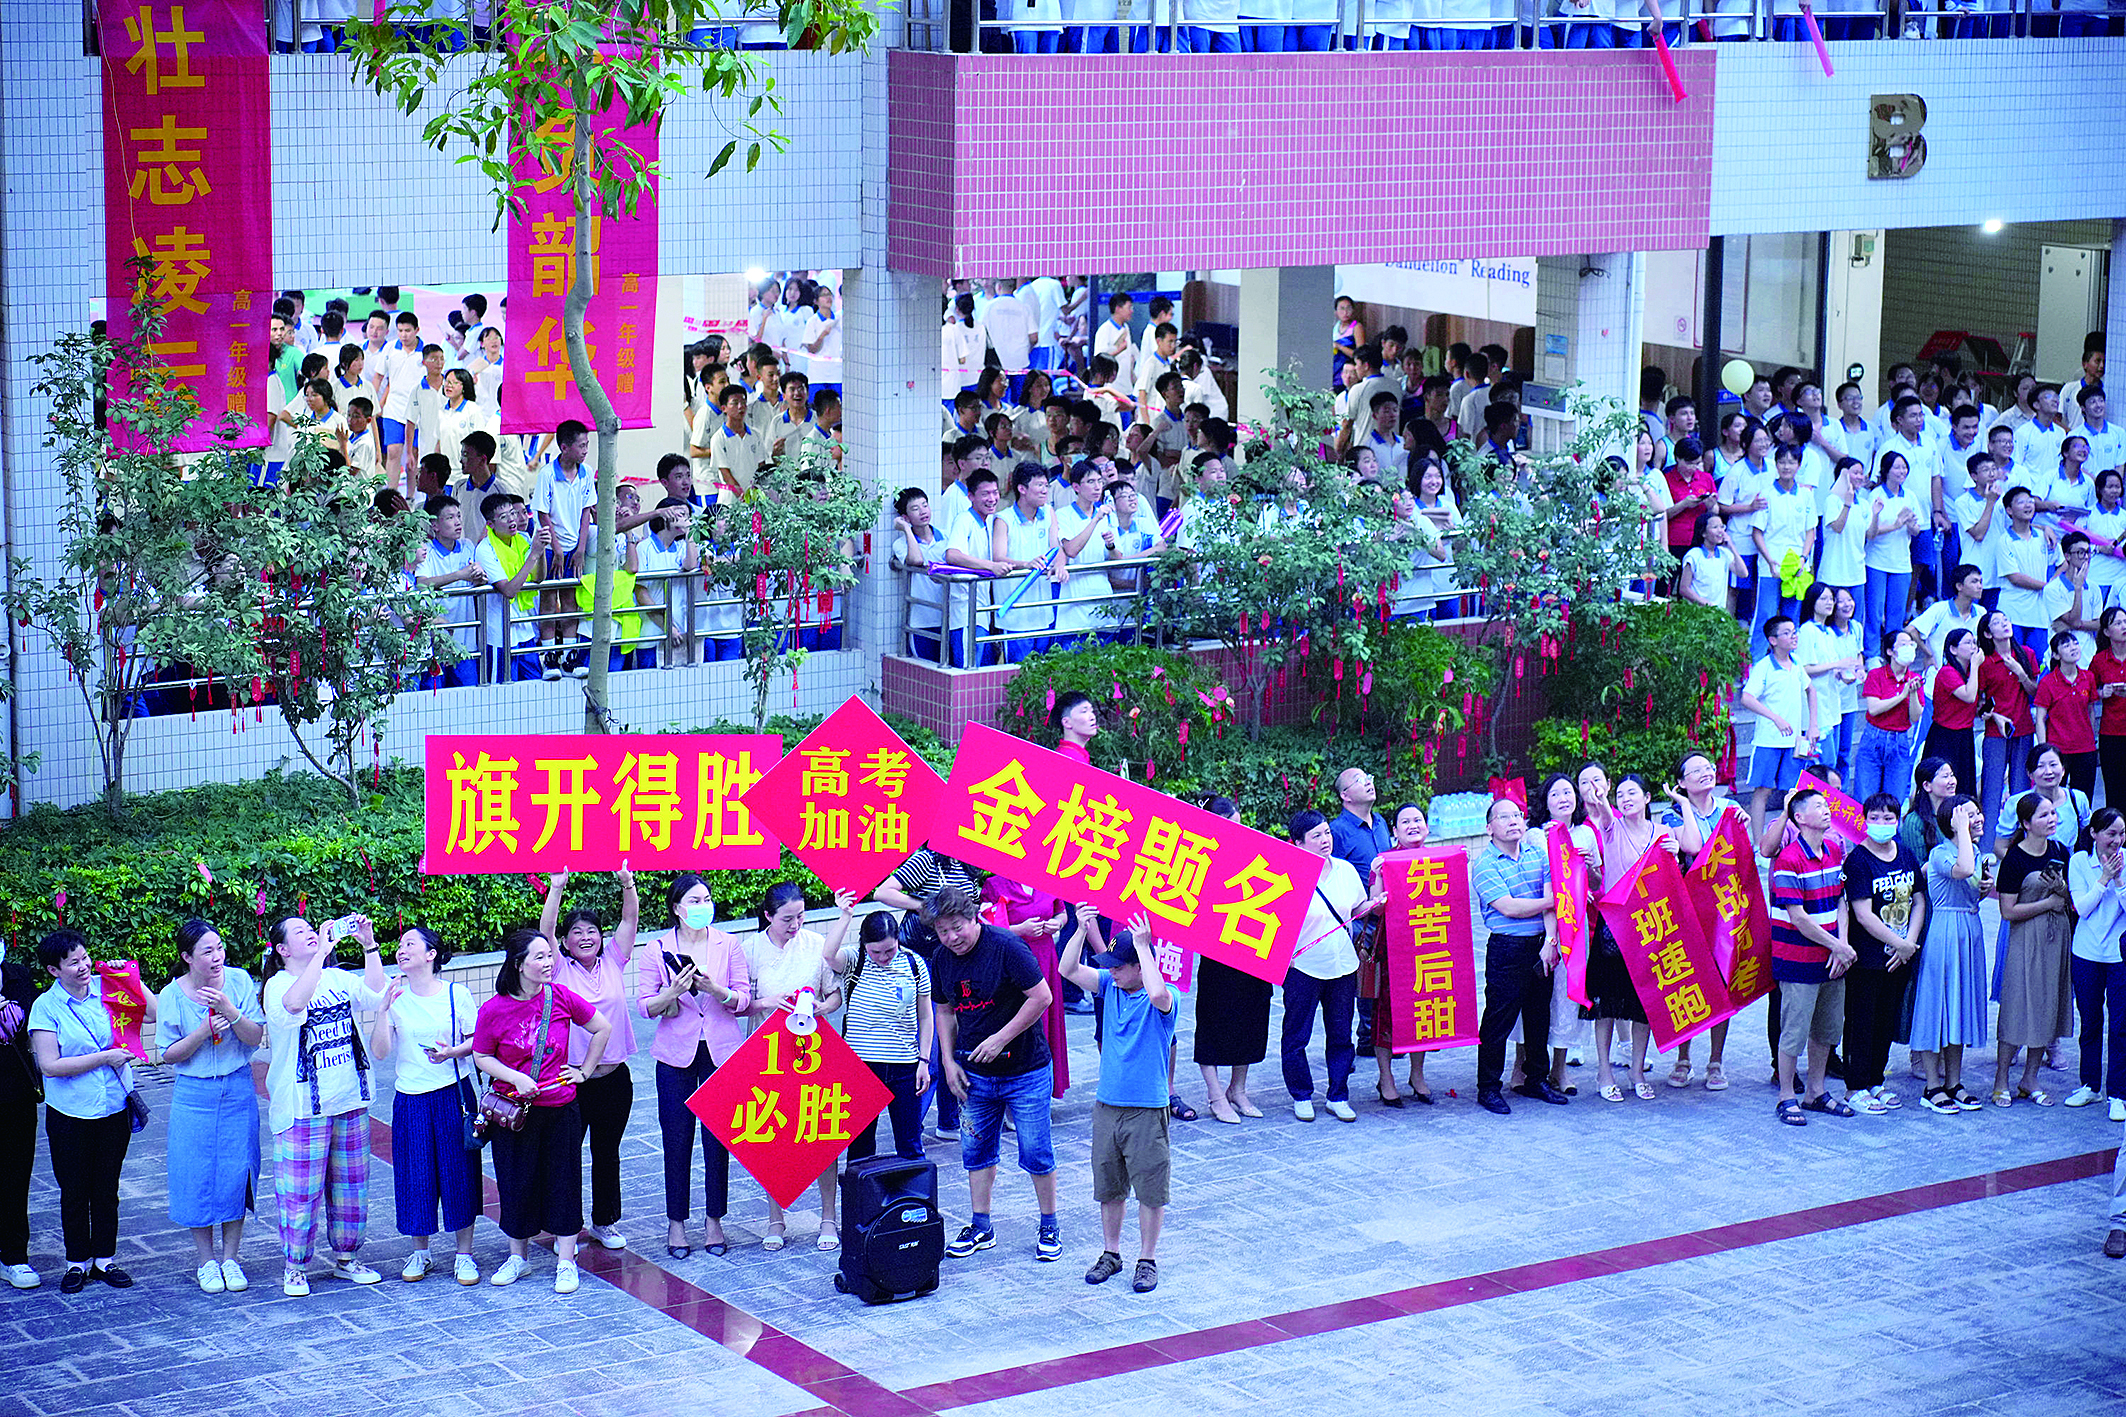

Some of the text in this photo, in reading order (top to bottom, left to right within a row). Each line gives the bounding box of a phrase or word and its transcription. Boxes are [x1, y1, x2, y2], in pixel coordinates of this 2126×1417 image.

[1868, 93, 1927, 179] B
[124, 5, 211, 417] 壮志凌云
[525, 11, 602, 400] 负韶华
[1471, 258, 1530, 288] Reading
[227, 288, 253, 413] 高一年级赠
[618, 272, 640, 394] 高一年级赠
[445, 750, 765, 855] 旗开得胜
[800, 745, 912, 799] 高考
[798, 801, 911, 853] 加油
[958, 758, 1294, 960] 金榜题名
[1407, 857, 1457, 1040] 先苦后甜
[106, 972, 138, 1049] 一飞冲
[760, 1032, 822, 1075] 13
[314, 1046, 355, 1070] Cheris
[731, 1083, 852, 1145] 必胜
